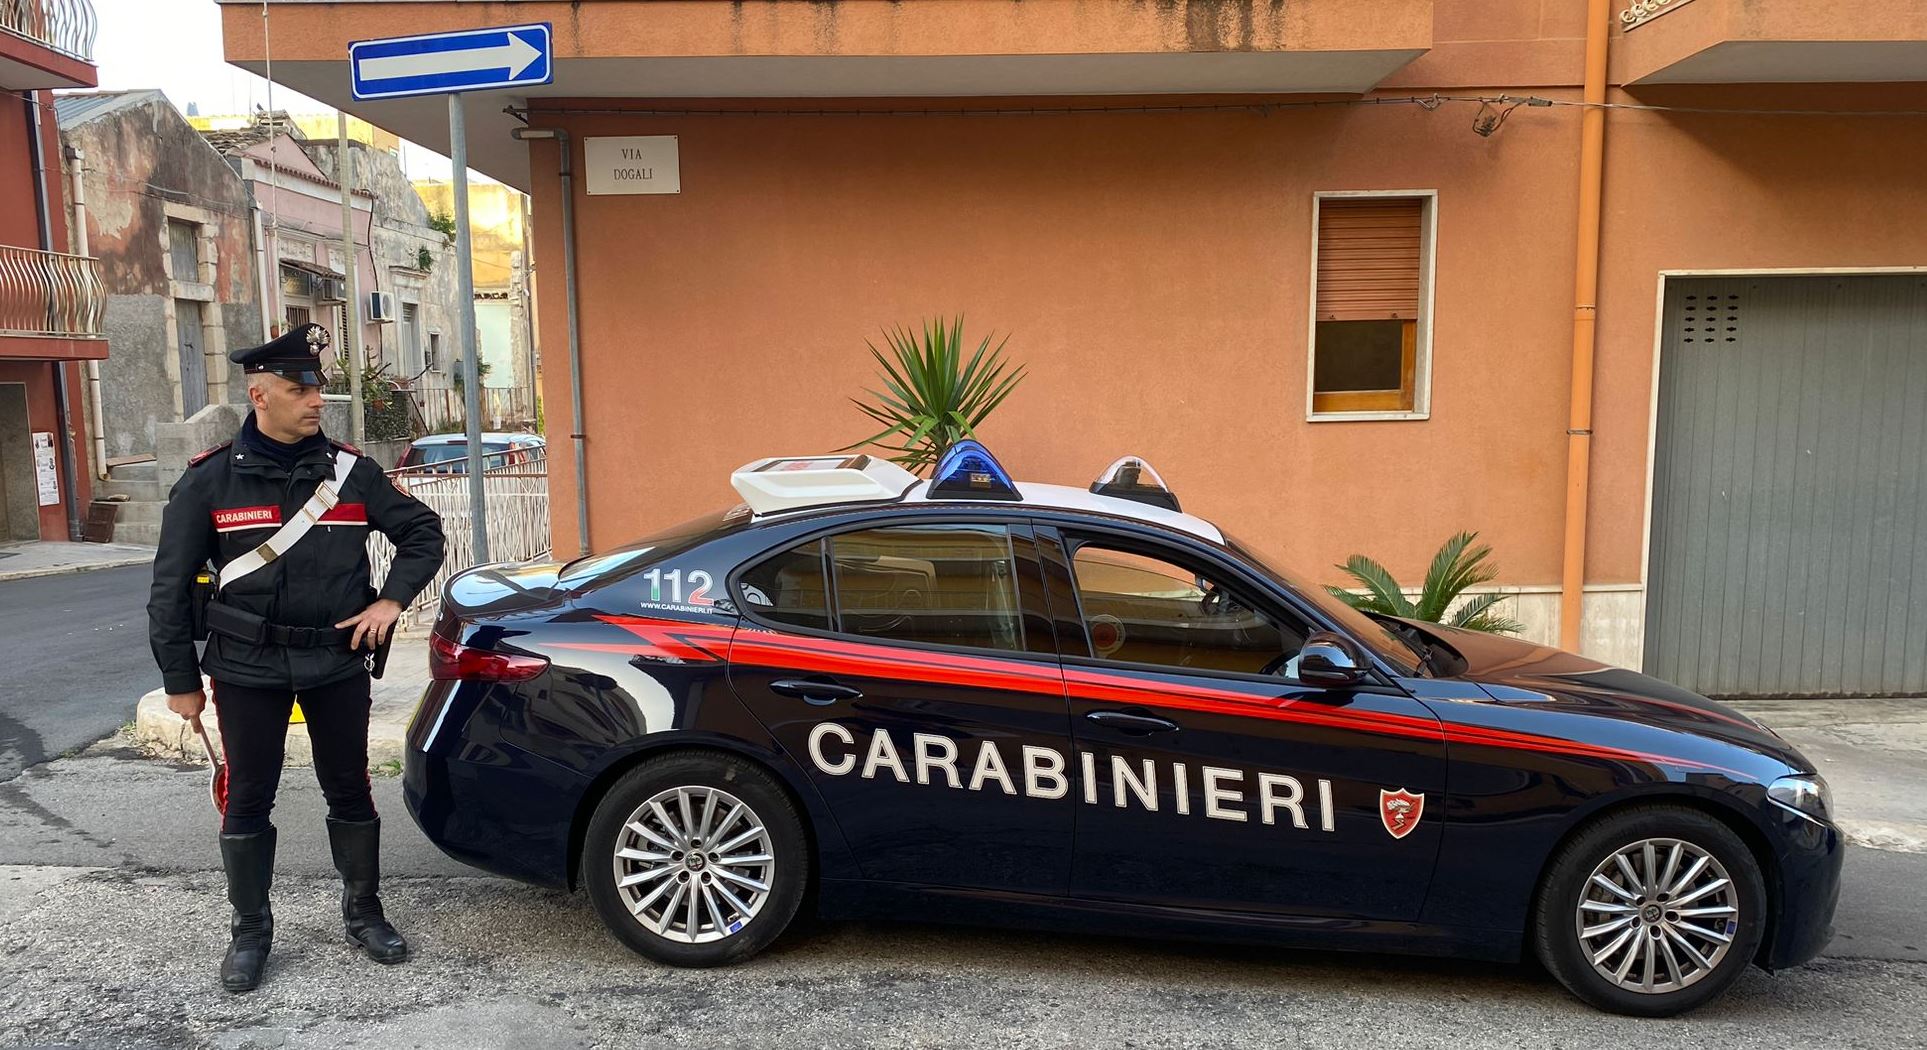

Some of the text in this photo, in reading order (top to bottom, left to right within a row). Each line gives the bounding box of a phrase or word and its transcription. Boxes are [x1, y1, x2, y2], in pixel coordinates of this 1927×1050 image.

[621, 148, 642, 160] VIA
[613, 168, 653, 180] DOGALI
[216, 510, 273, 524] CARABINIERI
[643, 568, 714, 606] 112
[640, 602, 713, 615] WWW.CARABINIERI.IT
[808, 722, 1335, 832] CARABINIERI
